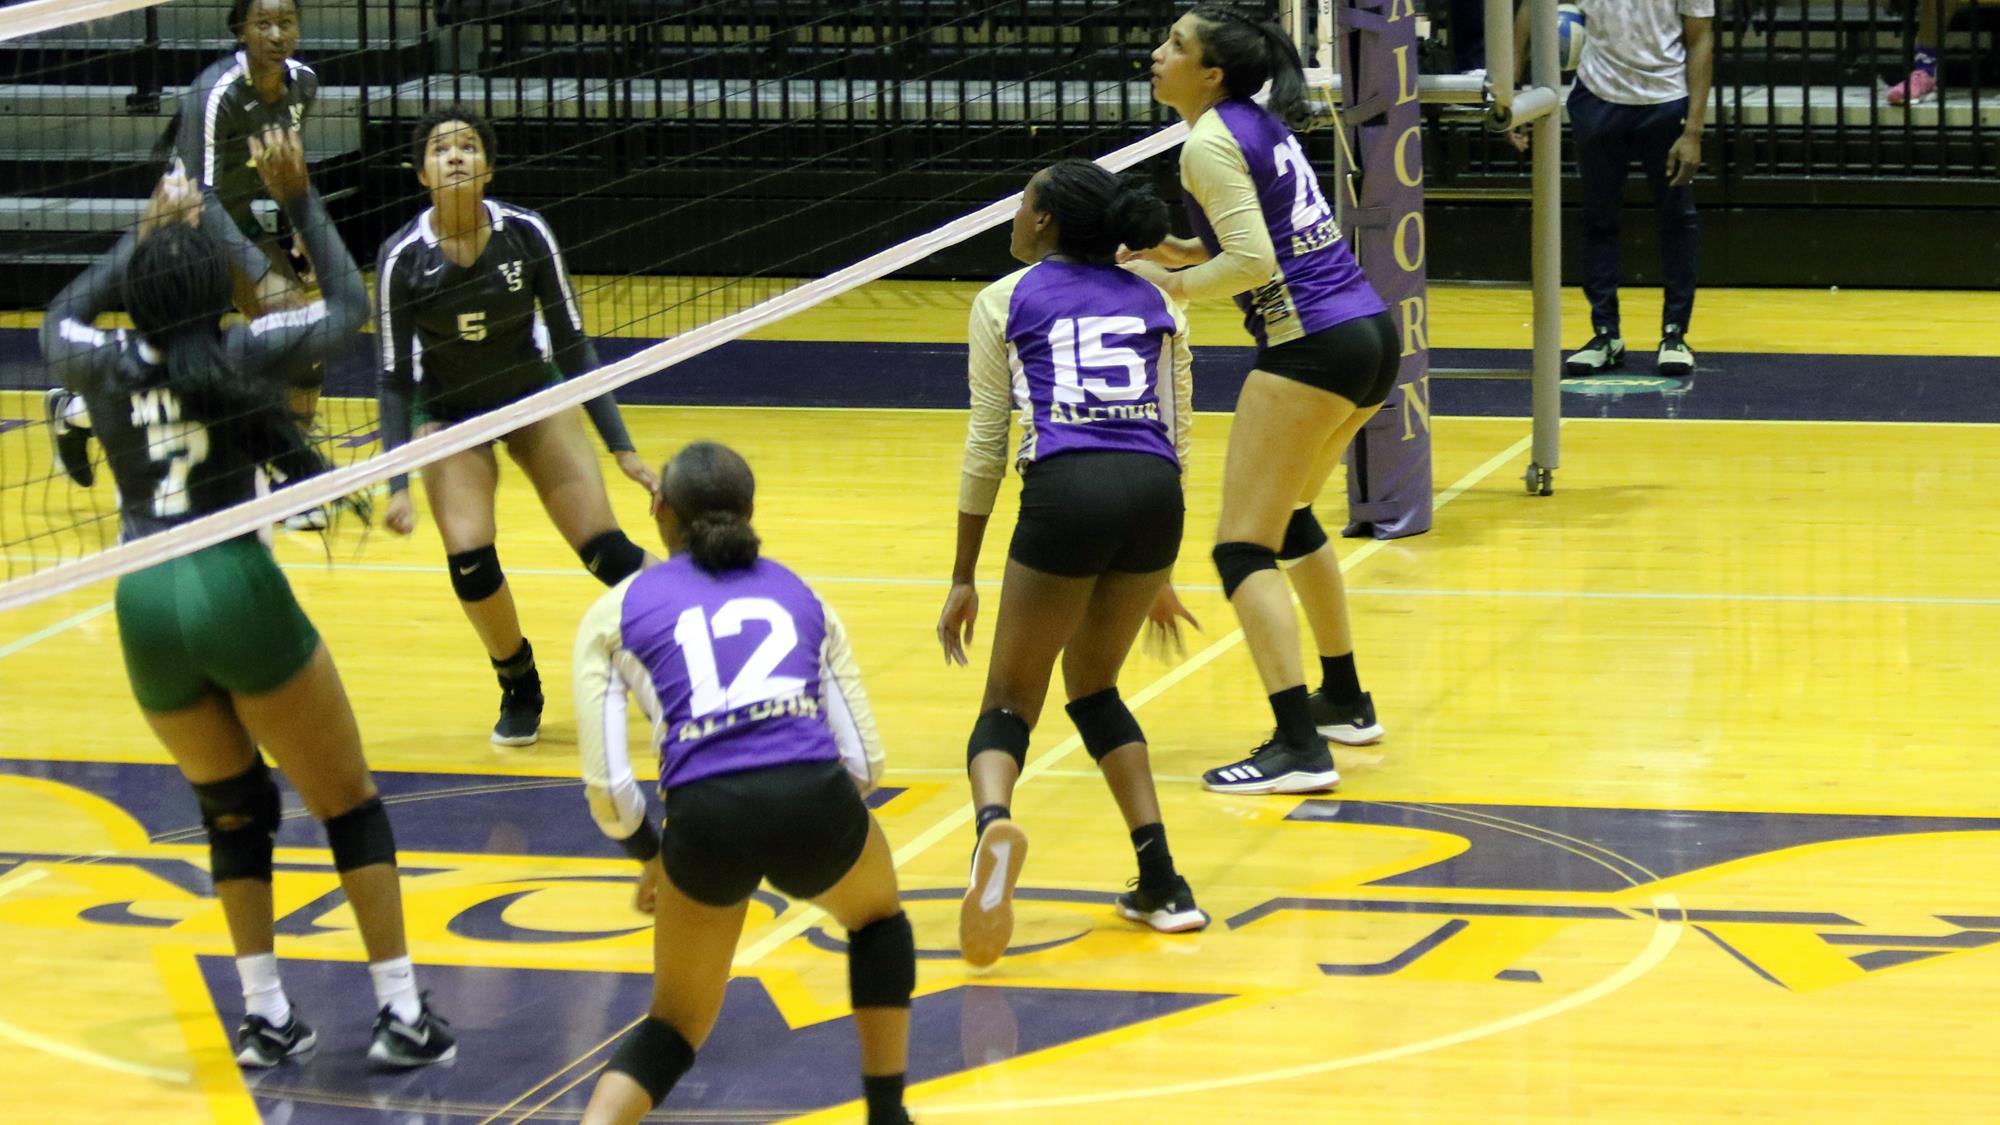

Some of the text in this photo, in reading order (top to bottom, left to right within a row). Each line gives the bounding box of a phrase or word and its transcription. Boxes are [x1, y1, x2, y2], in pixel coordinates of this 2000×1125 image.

[1273, 134, 1331, 232] 2
[457, 311, 487, 341] 5
[1048, 316, 1149, 403] 15
[147, 421, 209, 517] 7
[673, 597, 807, 719] 12
